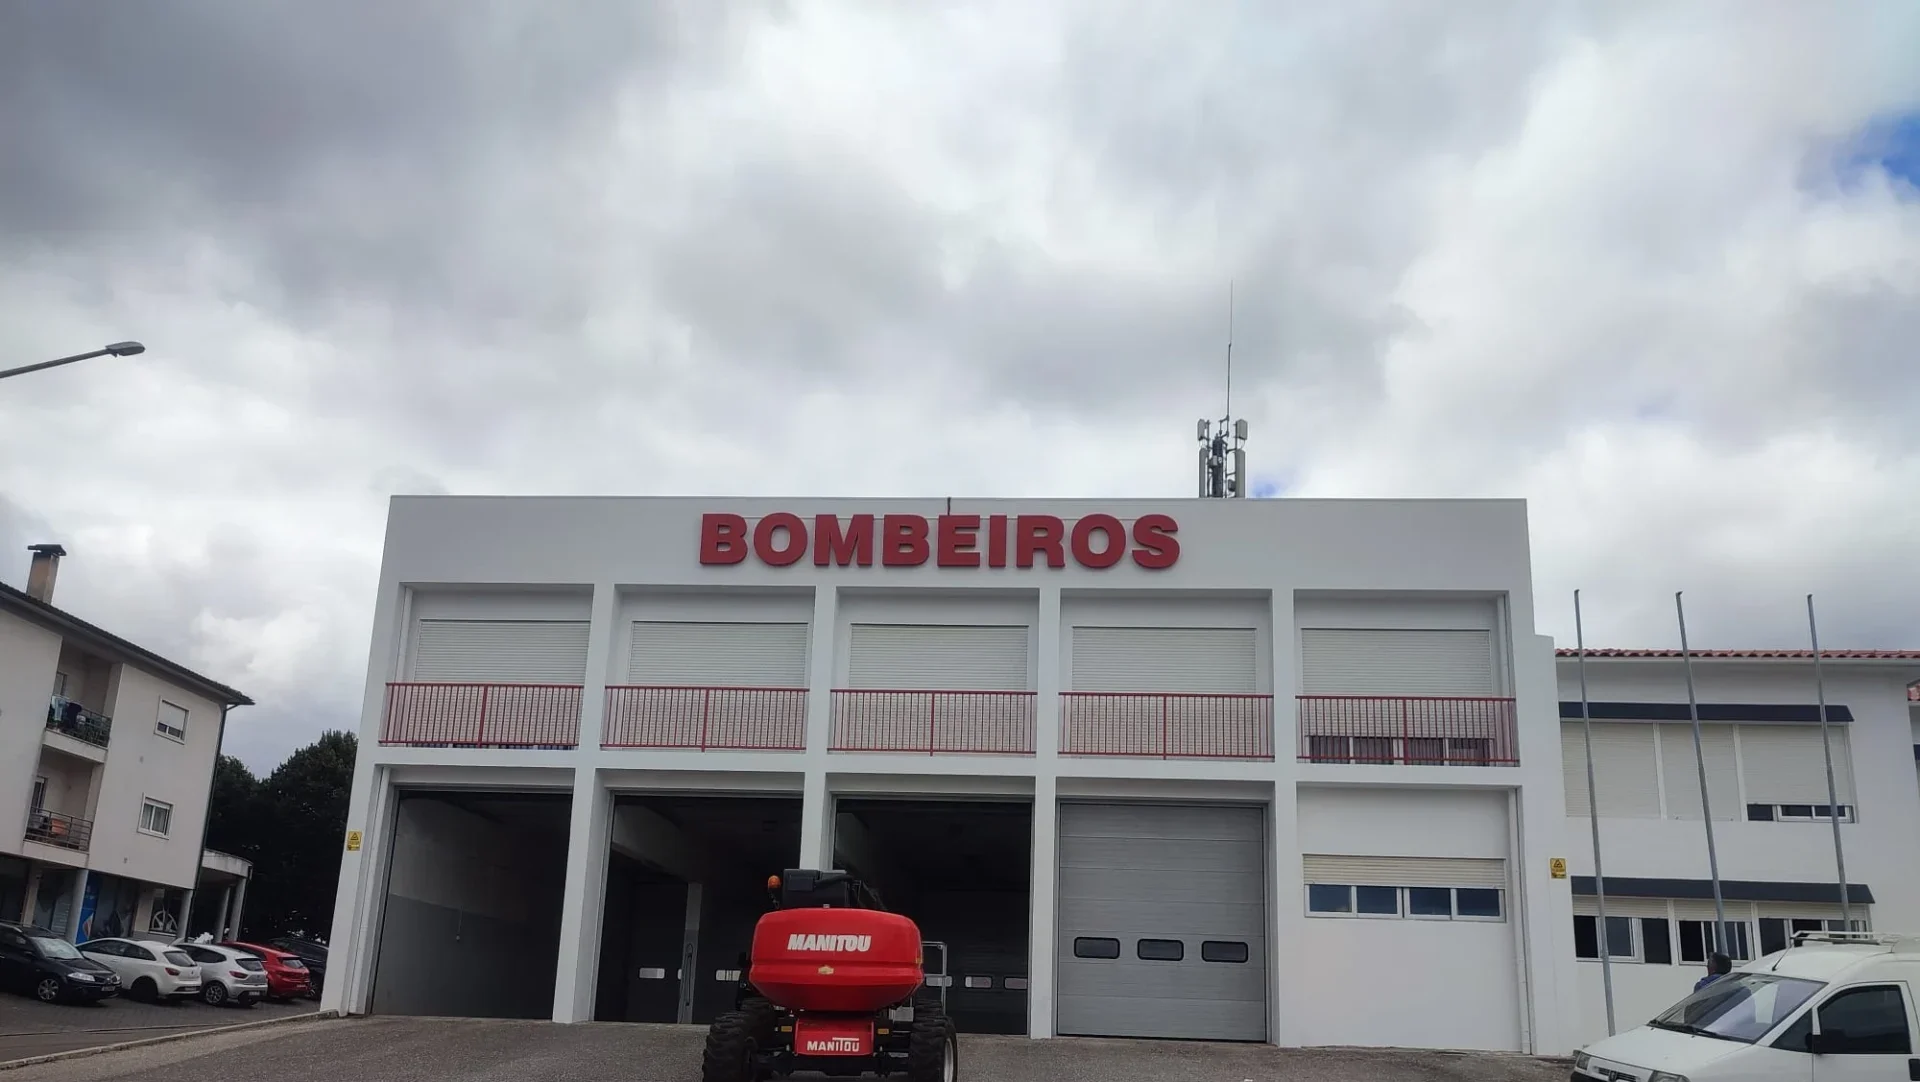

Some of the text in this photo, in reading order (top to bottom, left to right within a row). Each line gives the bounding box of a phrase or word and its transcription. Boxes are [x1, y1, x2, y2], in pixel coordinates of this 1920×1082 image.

[700, 513, 1181, 568] BOMBEIROS
[787, 934, 872, 952] MANITOU
[806, 1037, 860, 1052] MANITOU
